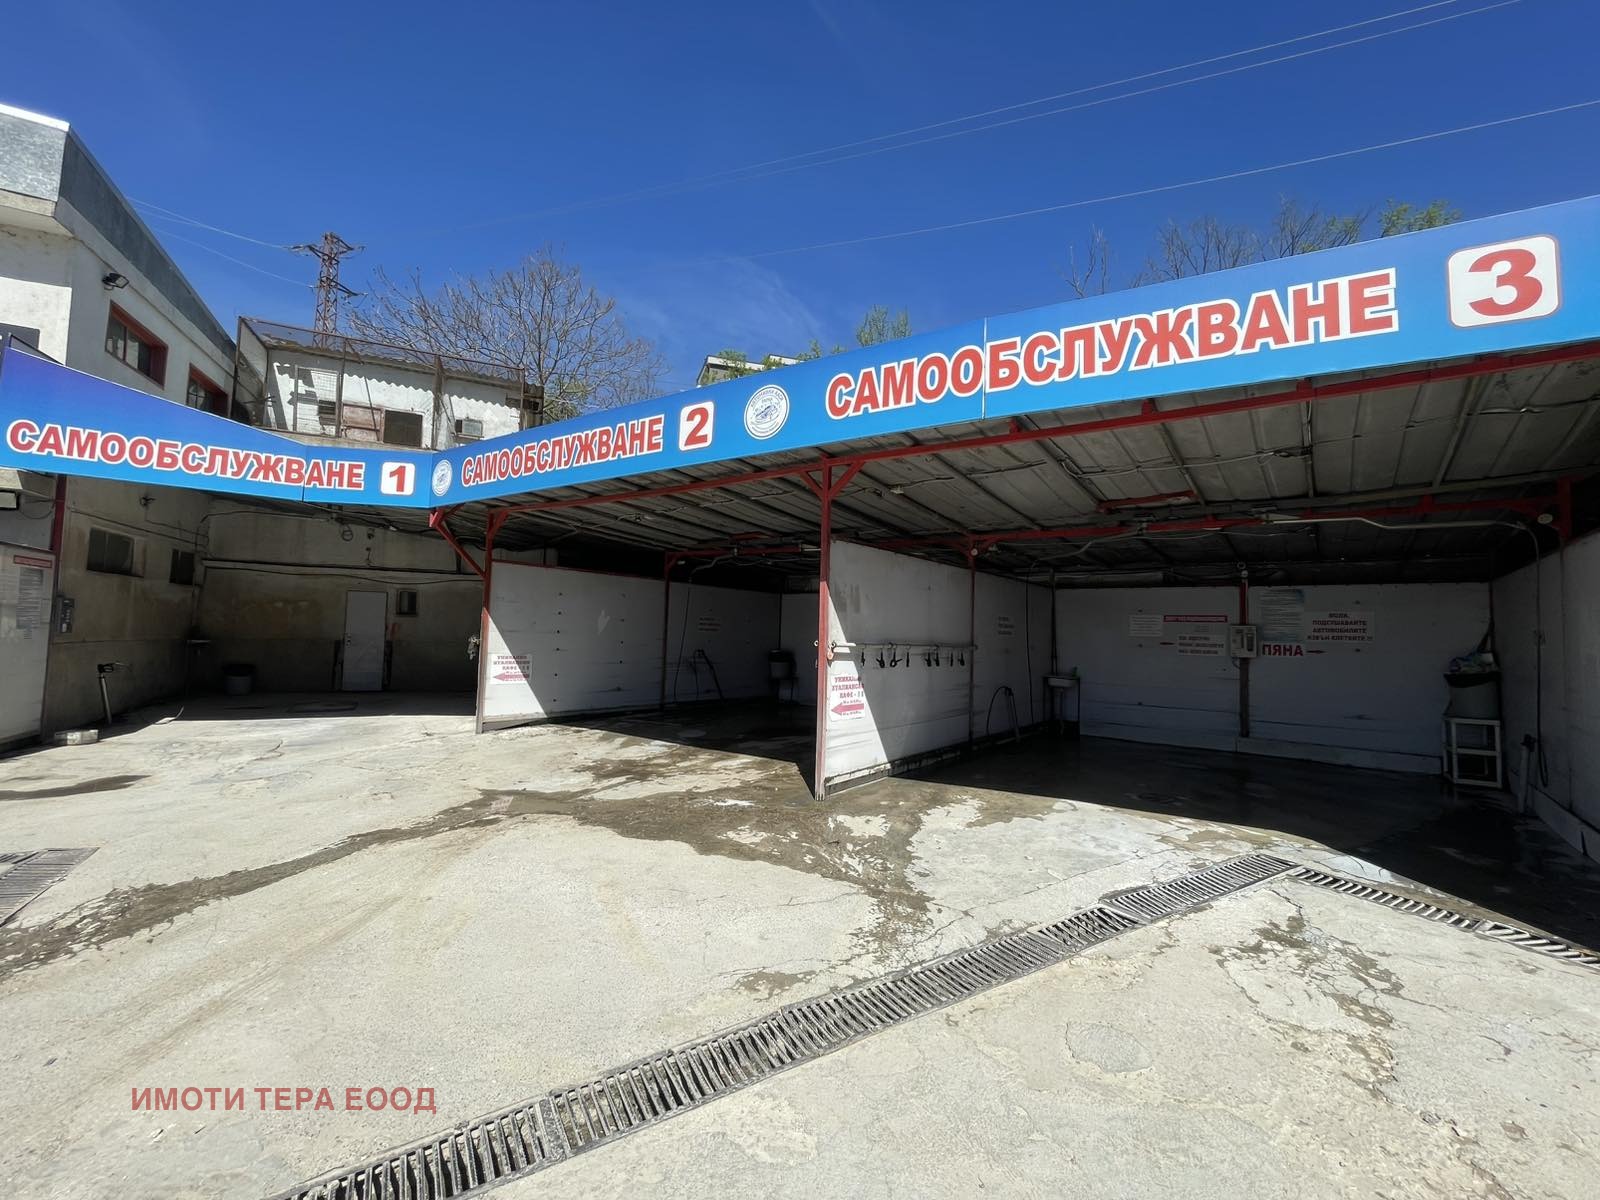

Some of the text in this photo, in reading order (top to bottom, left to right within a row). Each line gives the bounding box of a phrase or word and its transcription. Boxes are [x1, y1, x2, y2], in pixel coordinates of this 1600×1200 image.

[826, 249, 1542, 419] САМООБСЛУЖВАНЕ 3
[7, 419, 365, 489] САМООБСЛУЖВАНЕ
[389, 465, 407, 492] 1
[461, 415, 665, 486] САМООБСЛУЖВАНЕ
[684, 408, 709, 447] 2
[1262, 644, 1304, 656] ПЯНА
